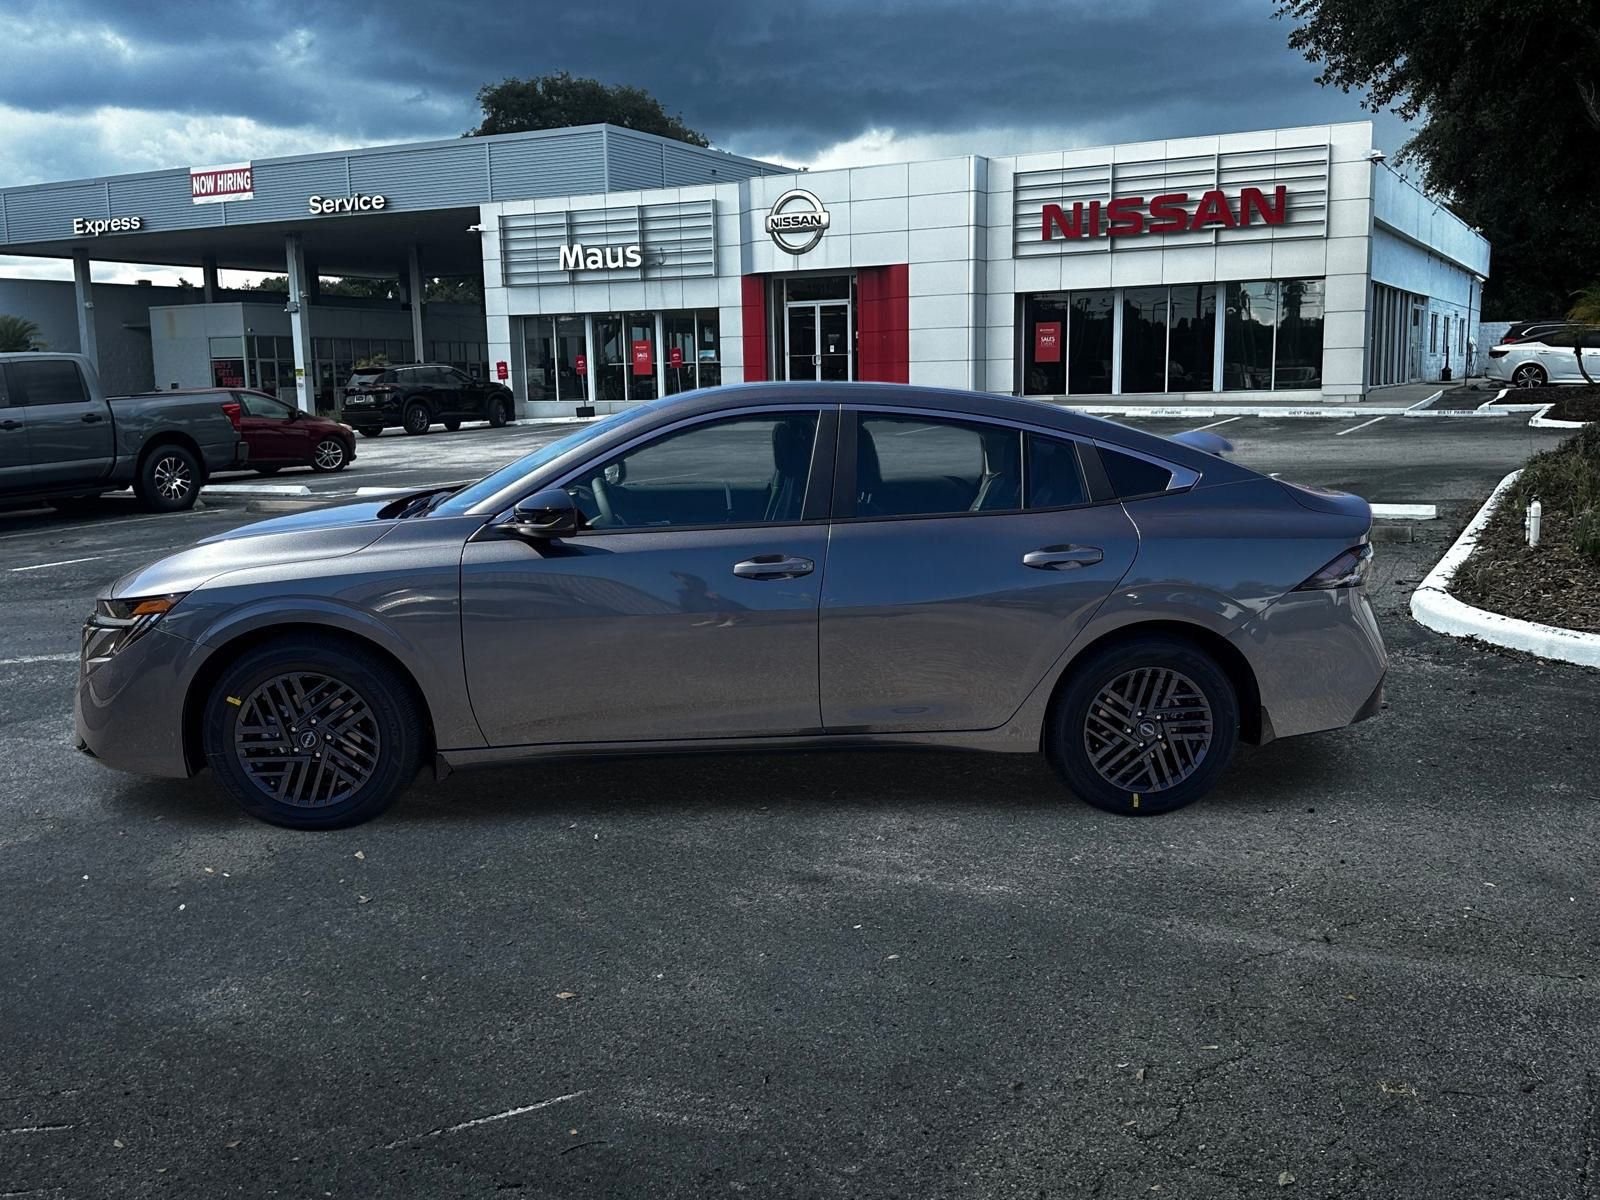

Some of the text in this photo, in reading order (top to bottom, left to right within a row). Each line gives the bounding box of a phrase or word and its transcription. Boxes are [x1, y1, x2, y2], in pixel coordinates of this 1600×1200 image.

[192, 171, 251, 195] NOW HIRING
[308, 192, 385, 214] Service
[1041, 184, 1287, 241] NISSAN
[73, 216, 141, 237] Express
[770, 214, 822, 228] NISSAN
[559, 243, 642, 271] Maus
